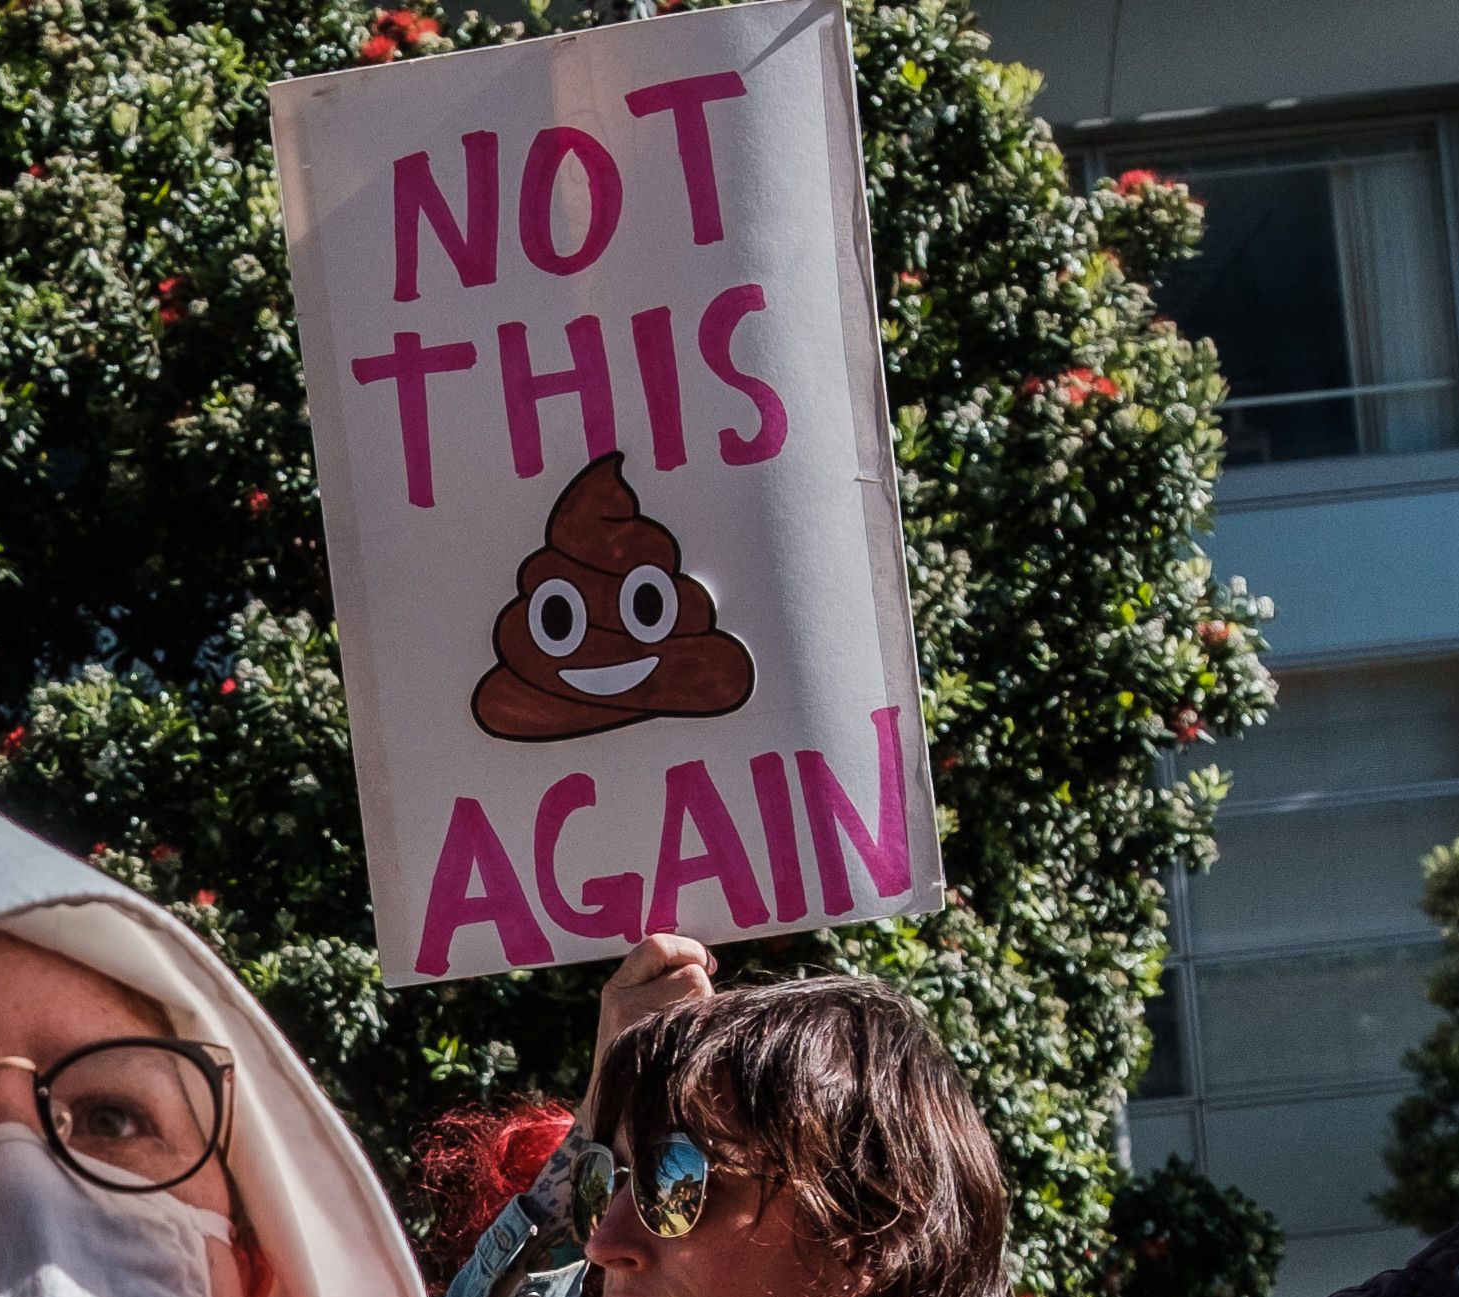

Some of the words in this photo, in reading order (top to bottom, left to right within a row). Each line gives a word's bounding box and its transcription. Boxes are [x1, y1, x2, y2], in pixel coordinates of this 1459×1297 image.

[392, 70, 748, 302] NOT
[351, 283, 789, 508] THIS
[414, 705, 914, 978] AGAIN
